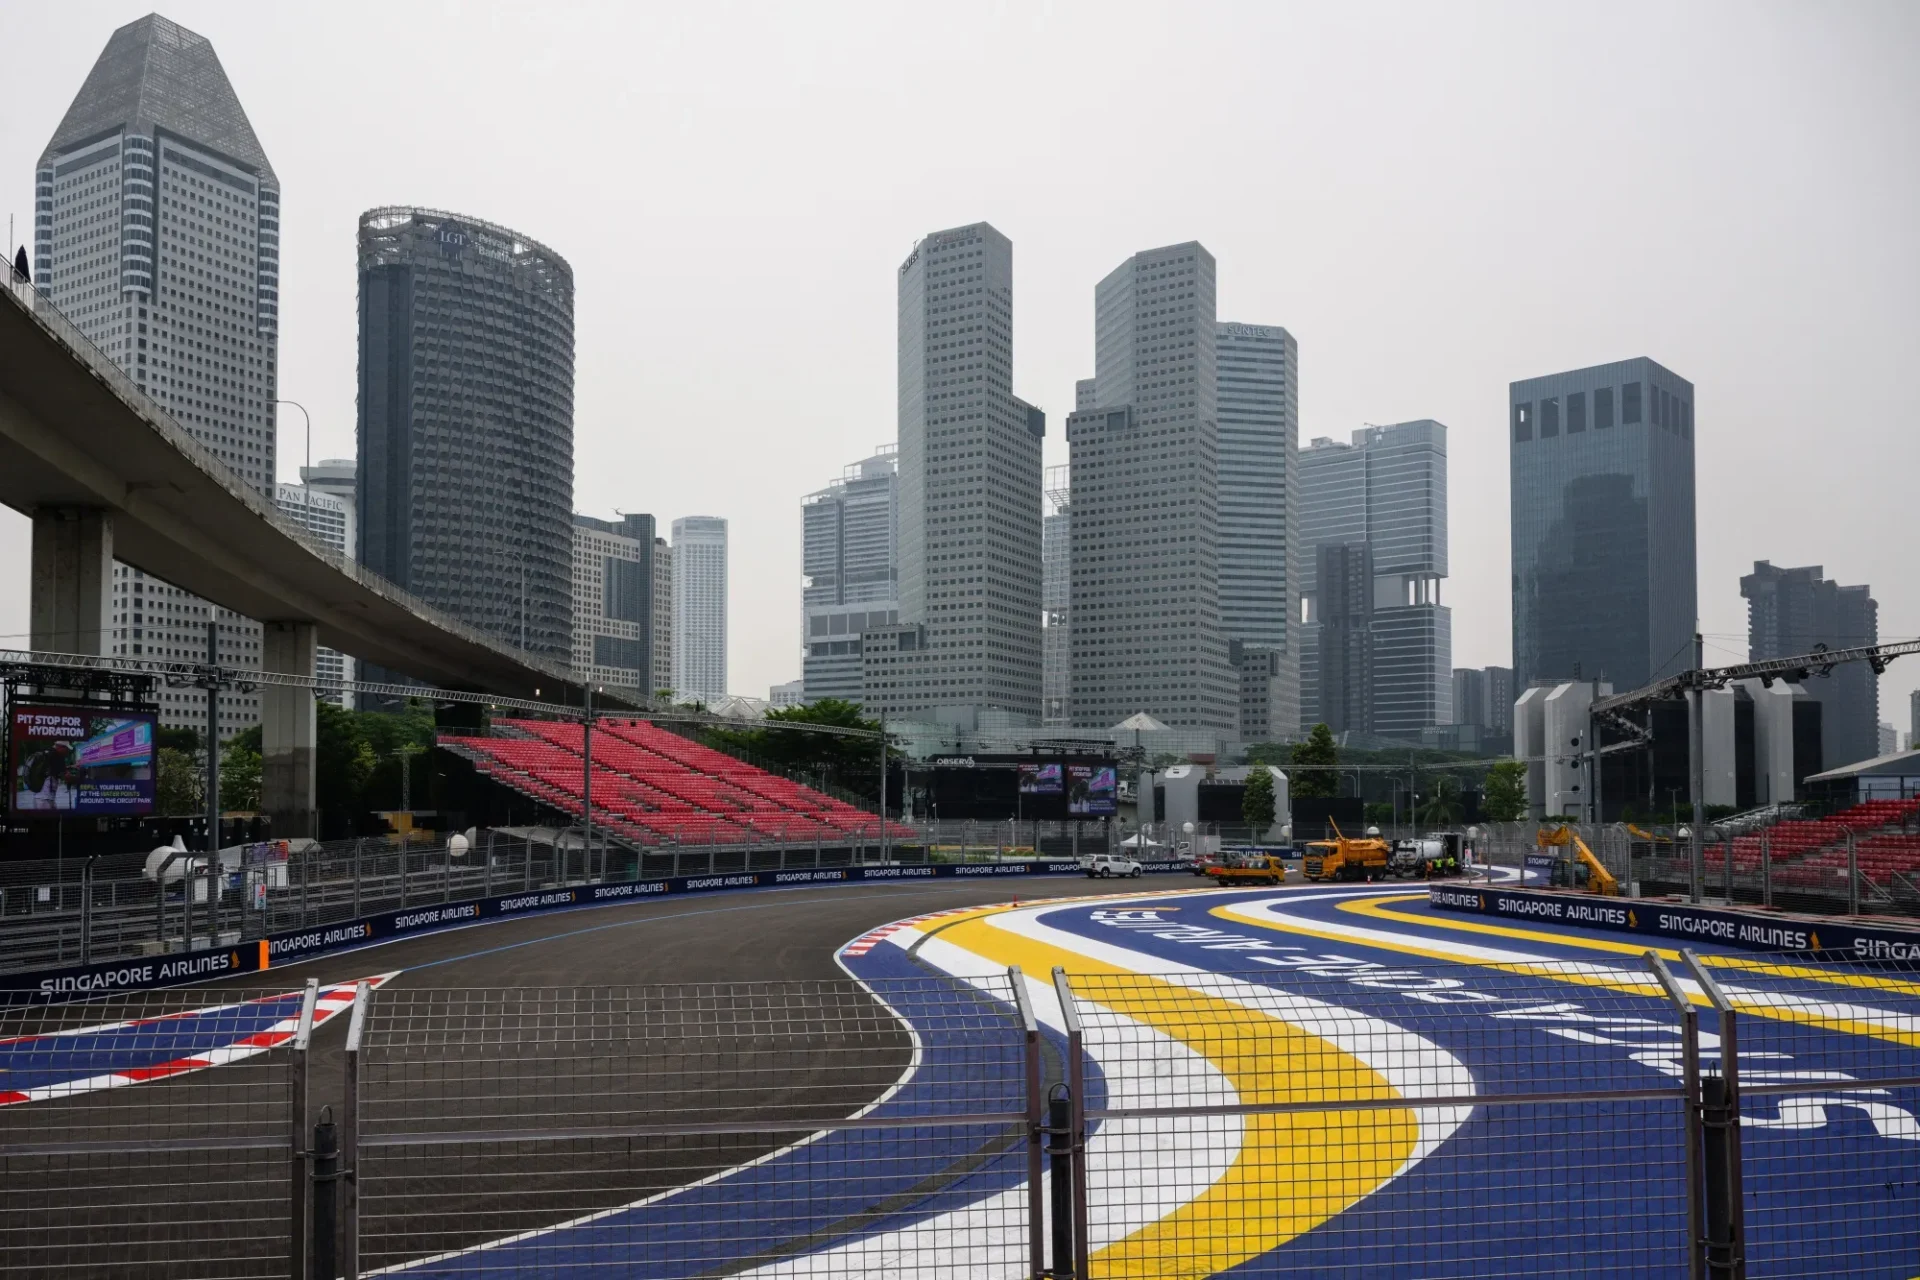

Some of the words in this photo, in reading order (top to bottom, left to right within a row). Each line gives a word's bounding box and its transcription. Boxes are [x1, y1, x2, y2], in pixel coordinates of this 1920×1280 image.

[441, 230, 466, 245] LGT
[479, 246, 517, 268] Banking
[1227, 324, 1271, 337] SUNTEC
[279, 487, 300, 501] PAN
[17, 714, 32, 725] PIT
[35, 715, 60, 726] STOP
[62, 716, 81, 727] FOR
[28, 726, 84, 737] HYDRATION
[864, 869, 900, 878] SINGAPORE
[902, 868, 931, 876] AIRLINES
[955, 866, 993, 875] SINGAPORE
[995, 865, 1025, 873] AIRLINES
[1049, 864, 1081, 872] SINGAPO
[687, 877, 723, 889] SINGAPORE
[724, 875, 754, 887] AIRLINES
[776, 872, 811, 882] SINGAPORE
[813, 871, 842, 880] AIRLINES
[594, 885, 632, 898] SINGAPORE
[633, 882, 664, 895] AIRLINES
[500, 895, 538, 912] SINGAPORE
[540, 892, 571, 907] AIRLINES
[1442, 892, 1479, 908] AIRLINES
[395, 910, 439, 929] SINGAPORE
[441, 905, 475, 921] AIRLINES
[1498, 898, 1562, 918] SINGAPORE
[1566, 905, 1626, 925] AIRLINES
[1659, 913, 1735, 939] SINGAPORE
[1739, 924, 1807, 949] AIRLINES
[269, 933, 321, 955] INGAPORE
[324, 924, 365, 946] AIRLINES
[40, 965, 153, 996] SINGAPORE
[159, 953, 229, 979] AIRLINES
